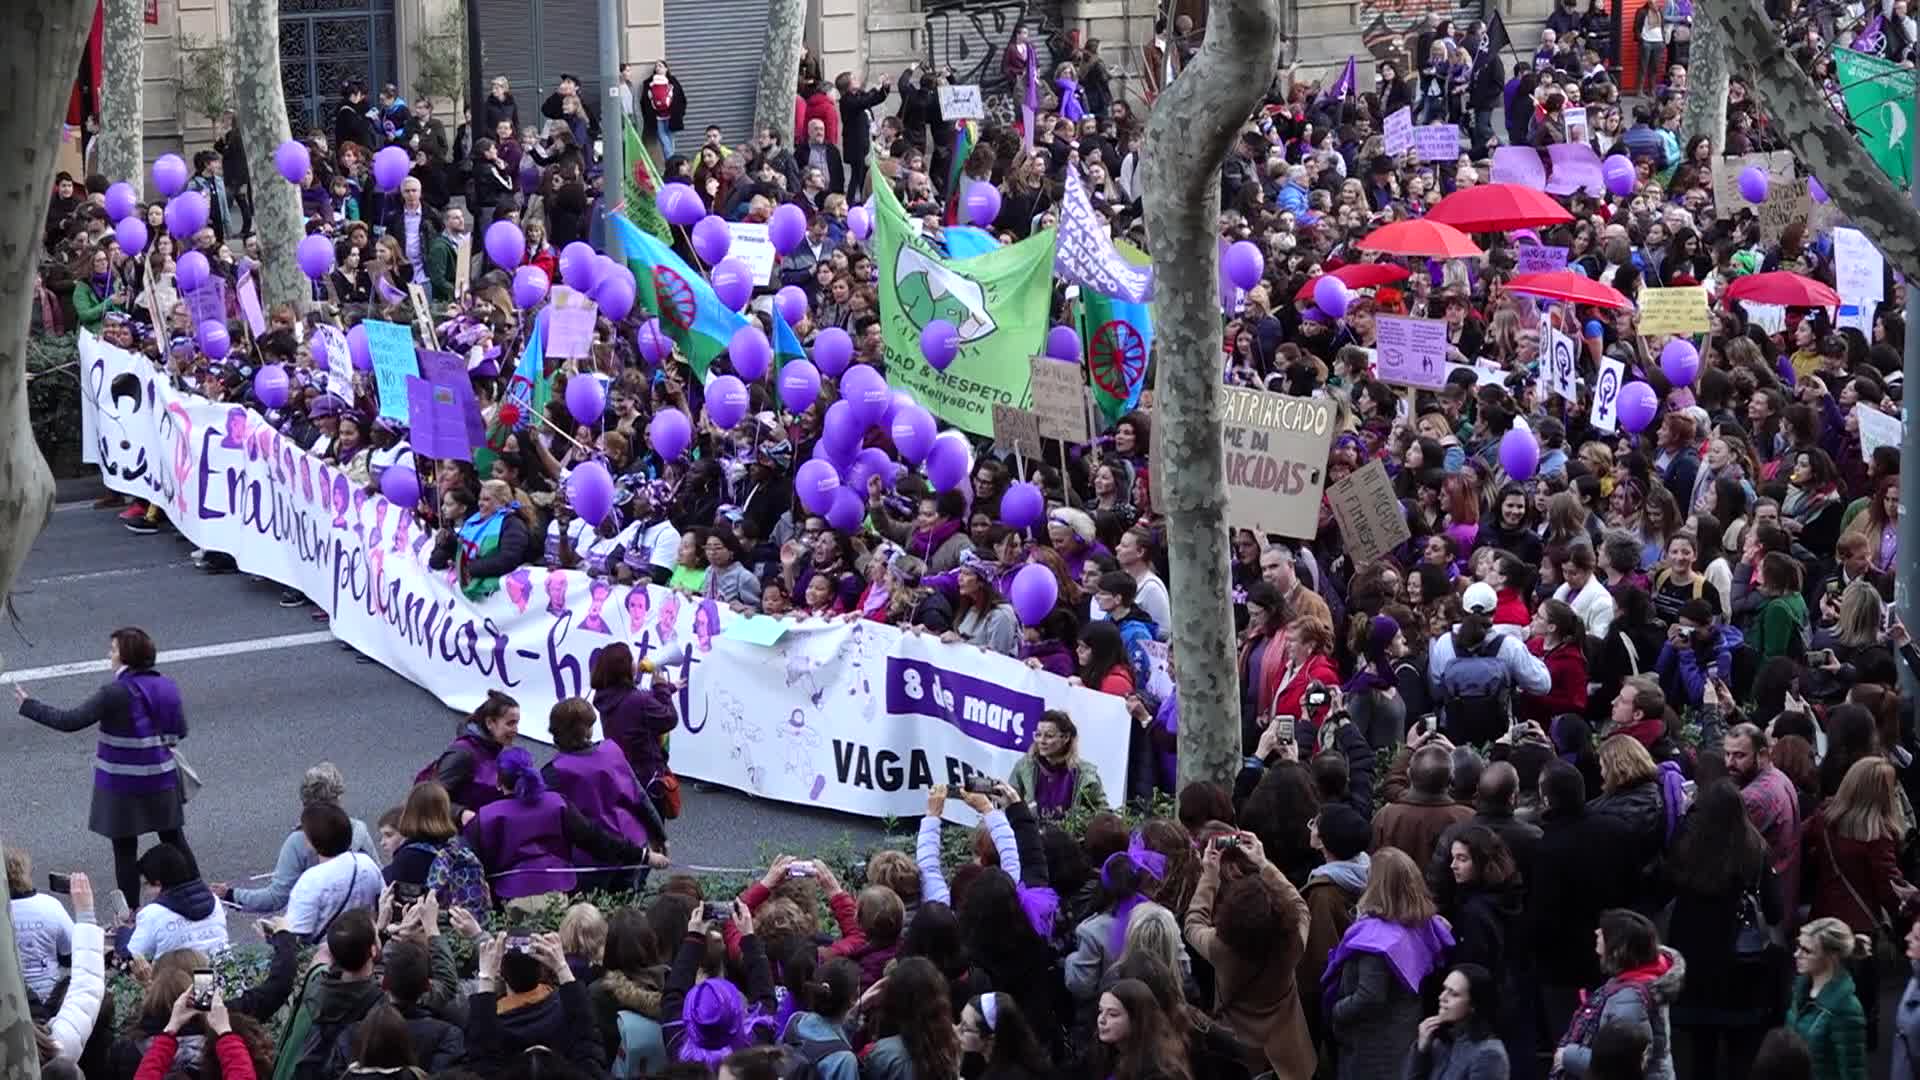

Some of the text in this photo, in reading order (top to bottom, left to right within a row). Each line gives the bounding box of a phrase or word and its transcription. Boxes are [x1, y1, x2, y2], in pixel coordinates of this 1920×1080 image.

[1224, 427, 1269, 452] ME DA
[902, 668, 1025, 745] 8 de març
[832, 739, 934, 792] VAGA
